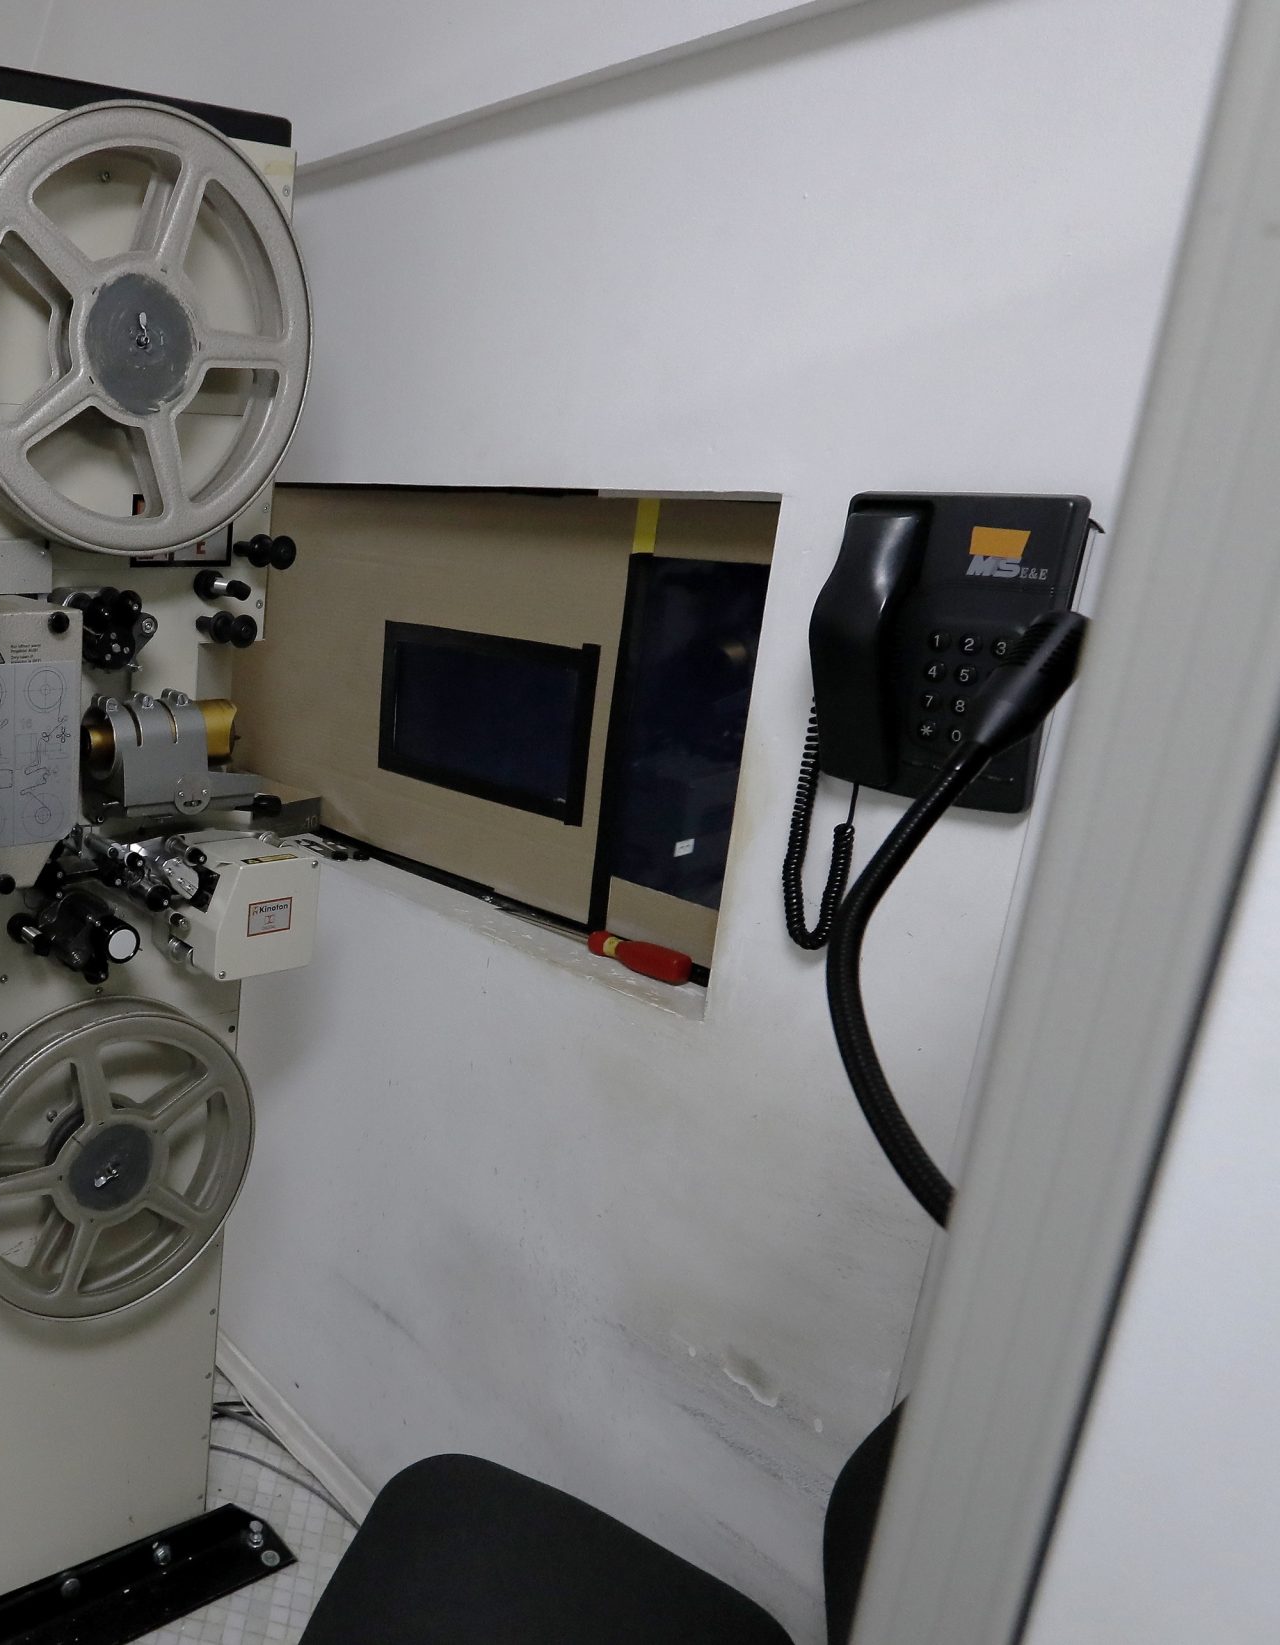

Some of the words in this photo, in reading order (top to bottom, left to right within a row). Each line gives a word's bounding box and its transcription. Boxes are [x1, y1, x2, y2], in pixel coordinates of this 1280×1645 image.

[934, 634, 940, 648] 1
[964, 638, 975, 651] 2
[996, 641, 1007, 655] 3
[928, 666, 937, 678] 4
[960, 669, 970, 682] 5
[925, 695, 934, 708] 7
[955, 700, 965, 713] 8
[951, 730, 962, 742] 0
[259, 903, 289, 913] Kinoton
